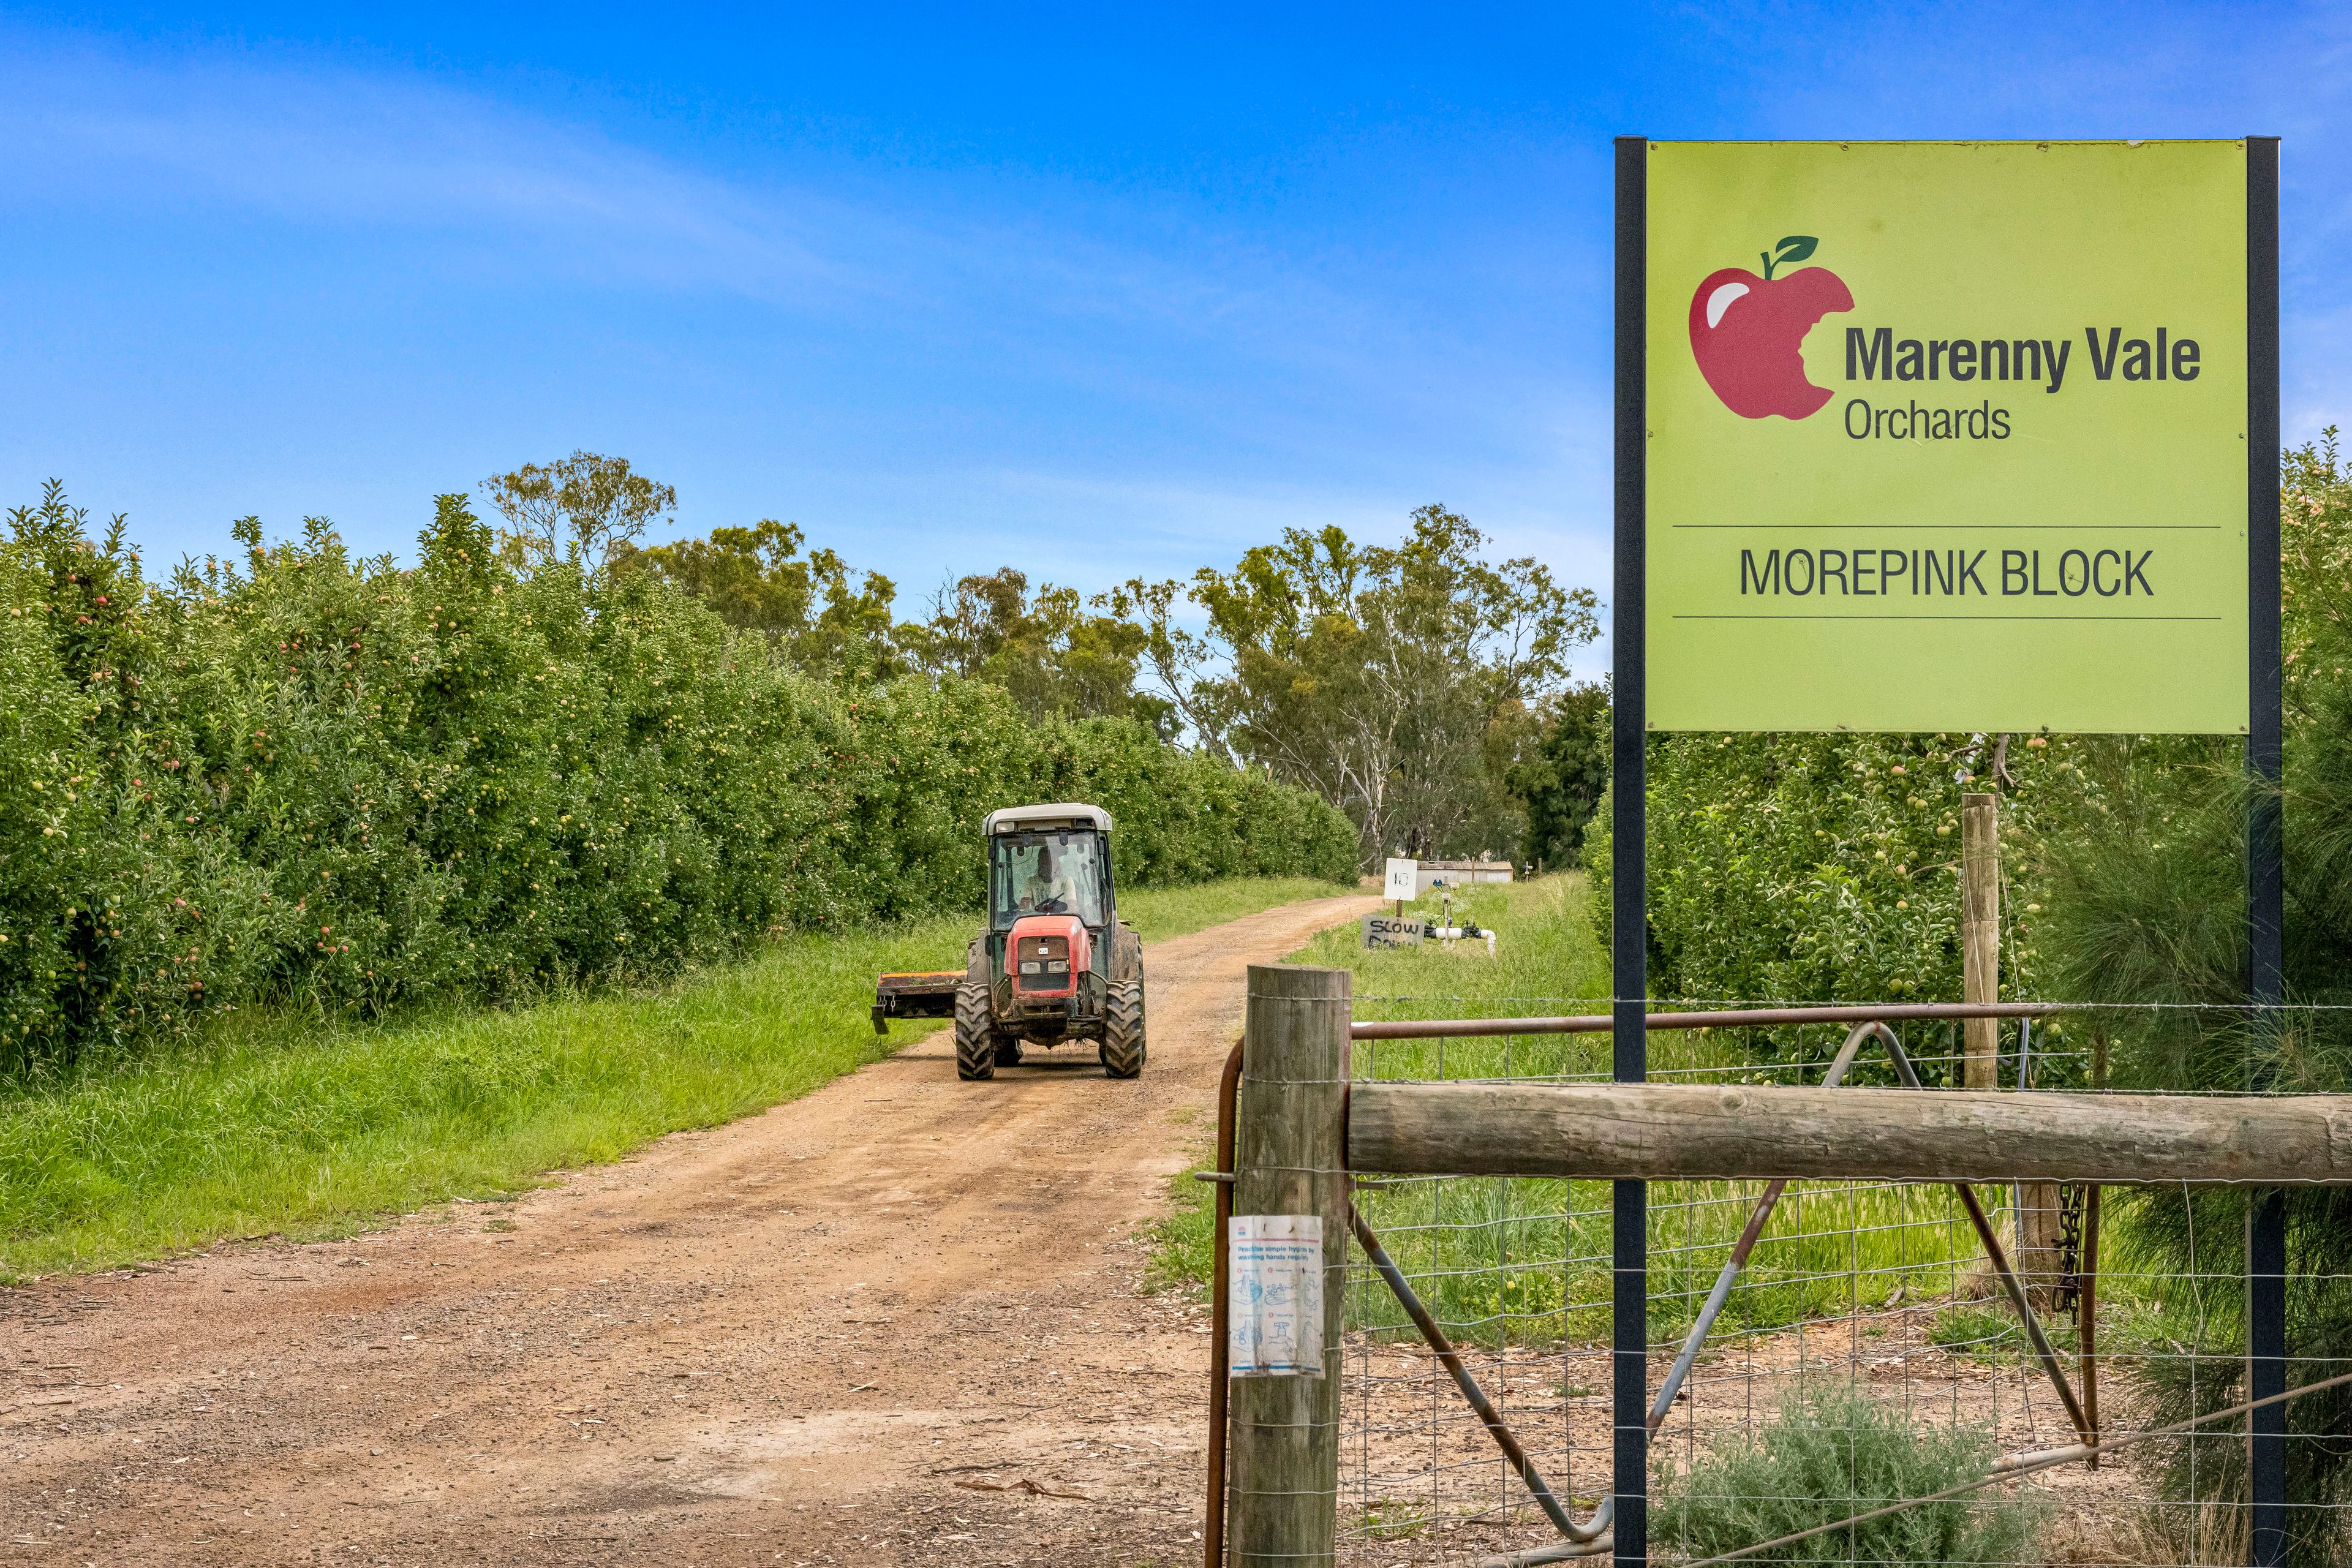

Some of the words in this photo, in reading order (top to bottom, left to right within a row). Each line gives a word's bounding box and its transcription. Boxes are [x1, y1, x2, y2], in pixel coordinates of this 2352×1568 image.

[1845, 327, 2072, 394] Marenny
[2084, 327, 2200, 382] Vale
[1845, 399, 2011, 440] Orchards
[1741, 548, 1988, 596] MOREPINK
[2002, 548, 2154, 597] BLOCK
[1370, 921, 1419, 934] SLOW
